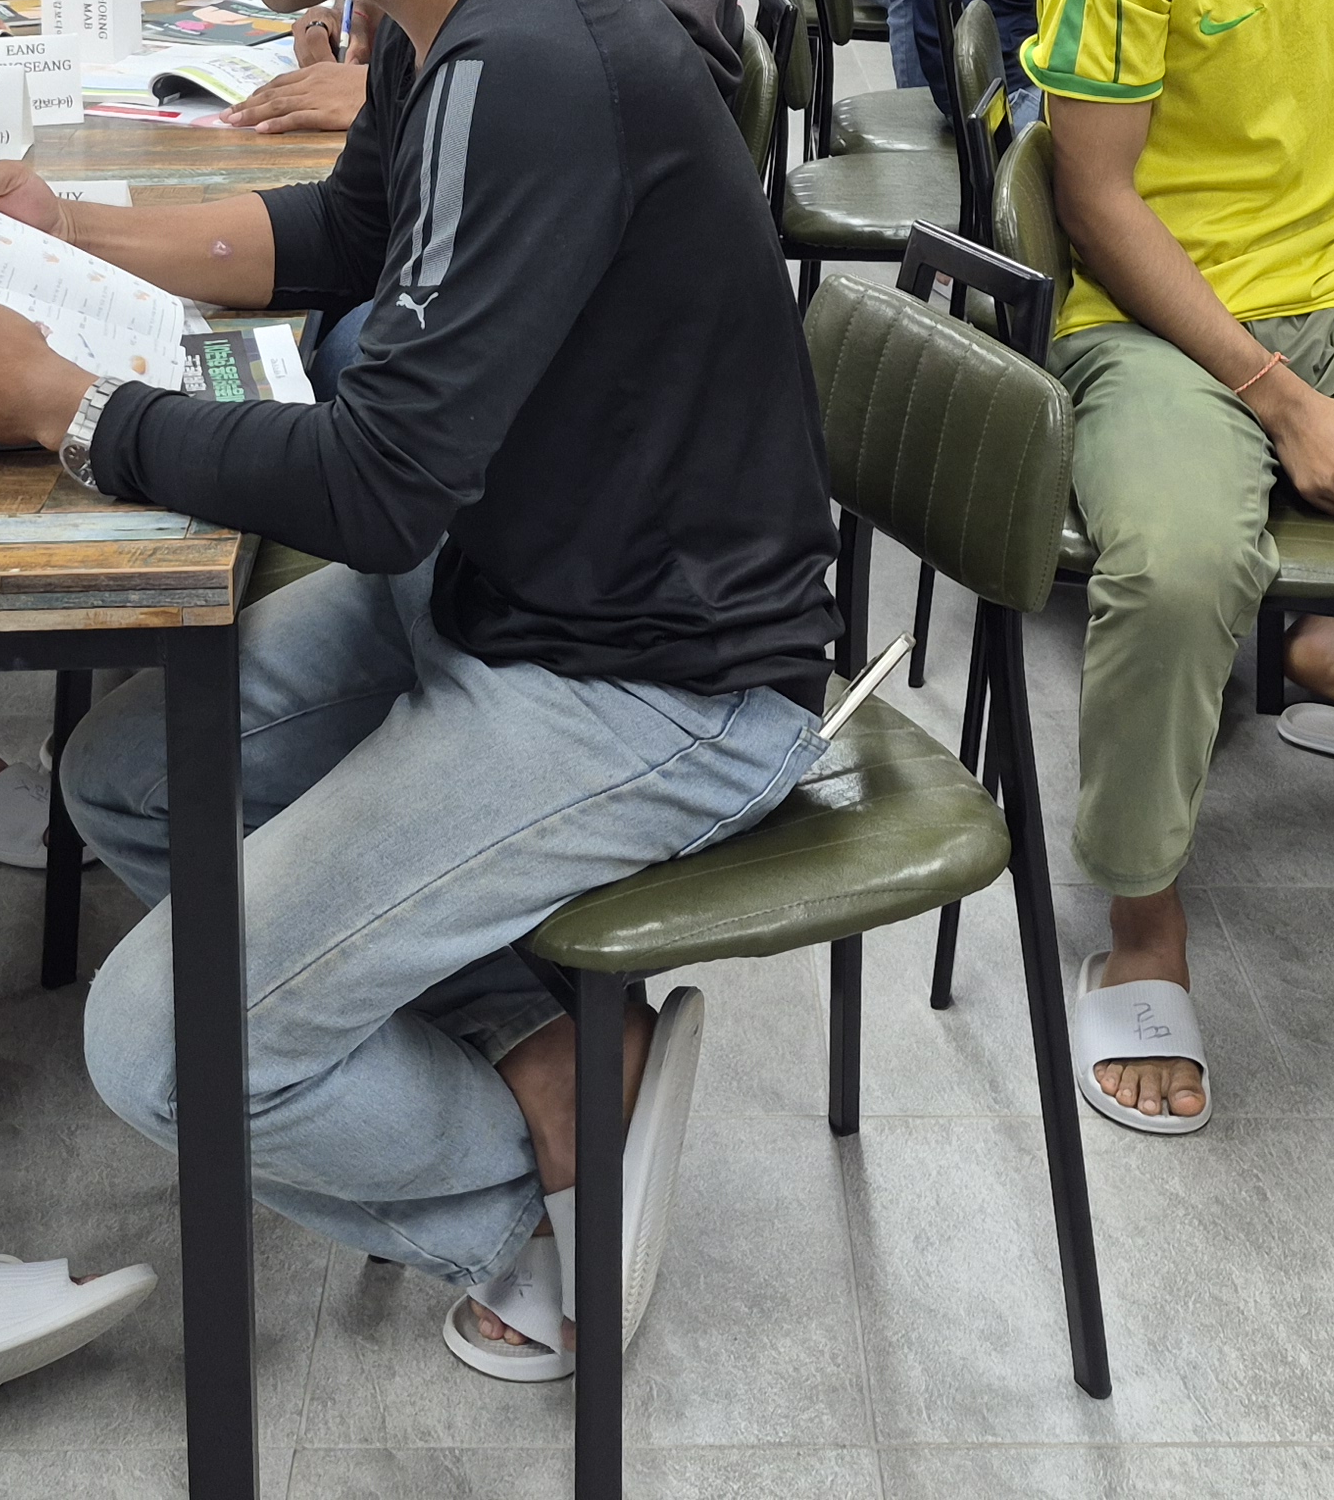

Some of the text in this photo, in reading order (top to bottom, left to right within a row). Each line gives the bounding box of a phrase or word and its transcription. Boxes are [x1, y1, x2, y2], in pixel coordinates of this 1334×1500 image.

[83, 3, 93, 30] MAB
[6, 43, 46, 56] EANG
[32, 95, 74, 111] 캄보디아)
